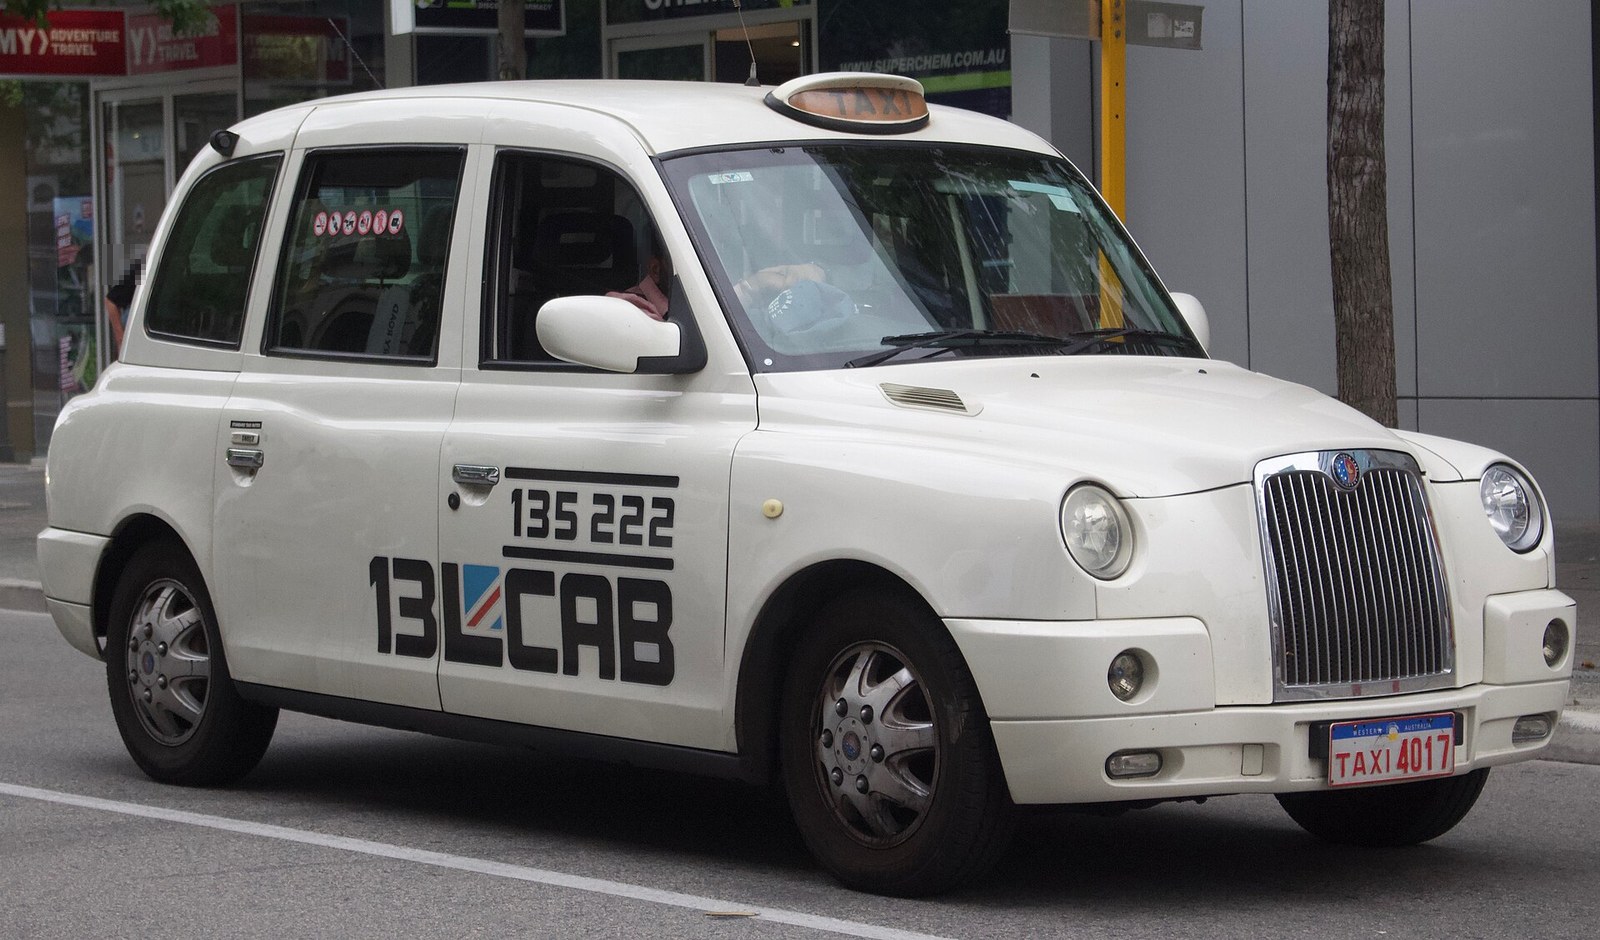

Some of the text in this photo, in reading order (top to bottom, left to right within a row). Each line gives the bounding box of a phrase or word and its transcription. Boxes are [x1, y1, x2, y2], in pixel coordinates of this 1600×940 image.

[50, 28, 119, 42] ADVENTURE
[51, 42, 97, 56] TRAVEL
[840, 48, 1007, 73] WWW.SUPERCHEM.COM.AU
[828, 87, 912, 116] TAXI
[511, 488, 675, 548] 135 222
[1353, 722, 1432, 736] WESTERN AUSTRALIA
[1335, 734, 1450, 778] TAXI 4017
